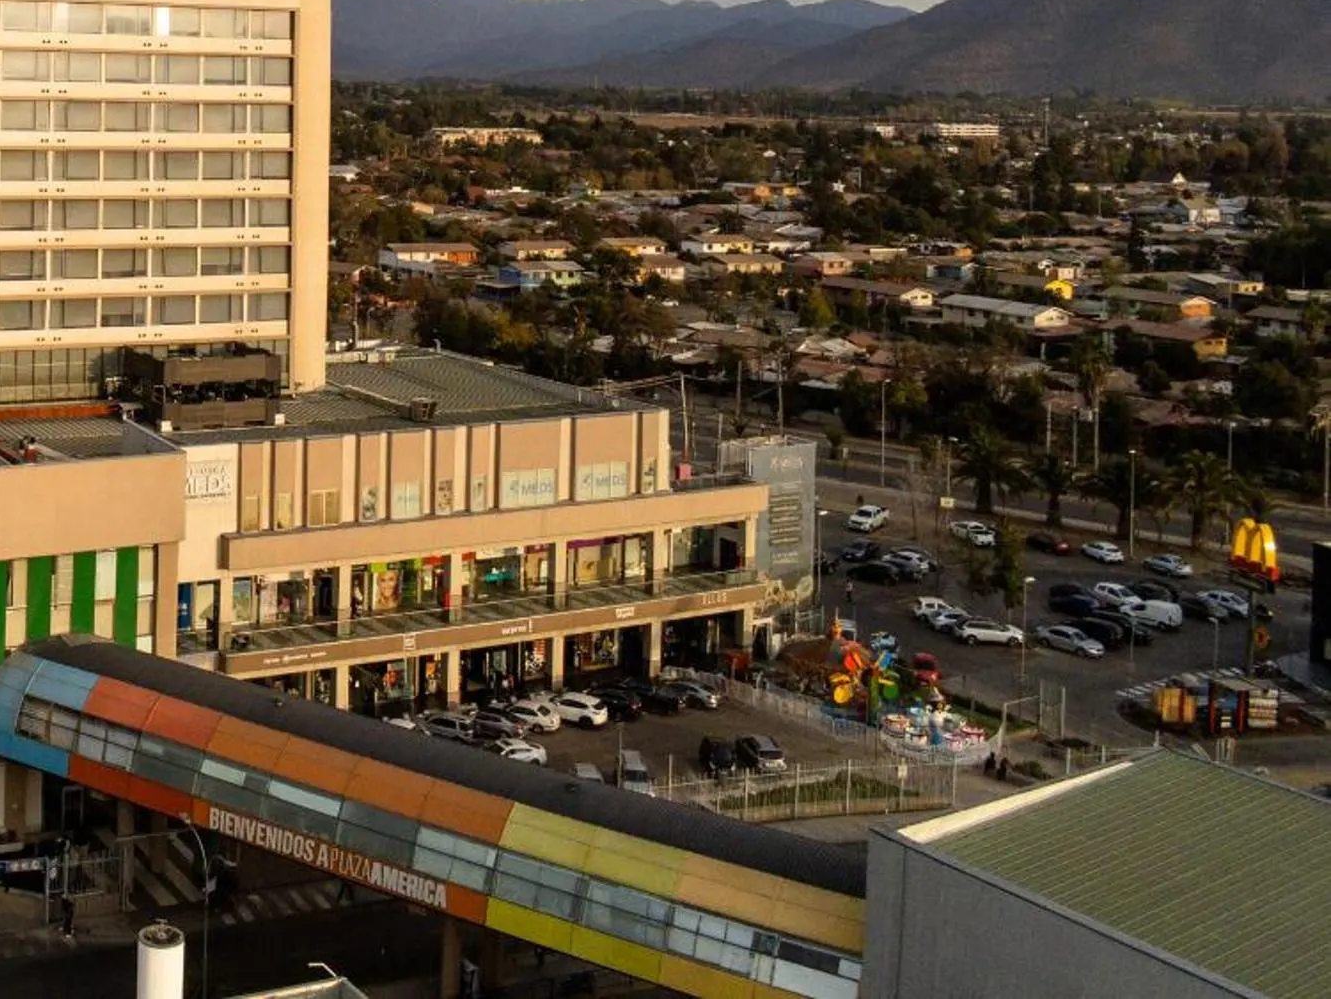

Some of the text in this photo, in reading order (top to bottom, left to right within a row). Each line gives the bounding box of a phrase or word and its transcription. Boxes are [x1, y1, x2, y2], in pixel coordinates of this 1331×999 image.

[209, 807, 447, 909] BIENVENIDOS A PLAZA AMERICA
